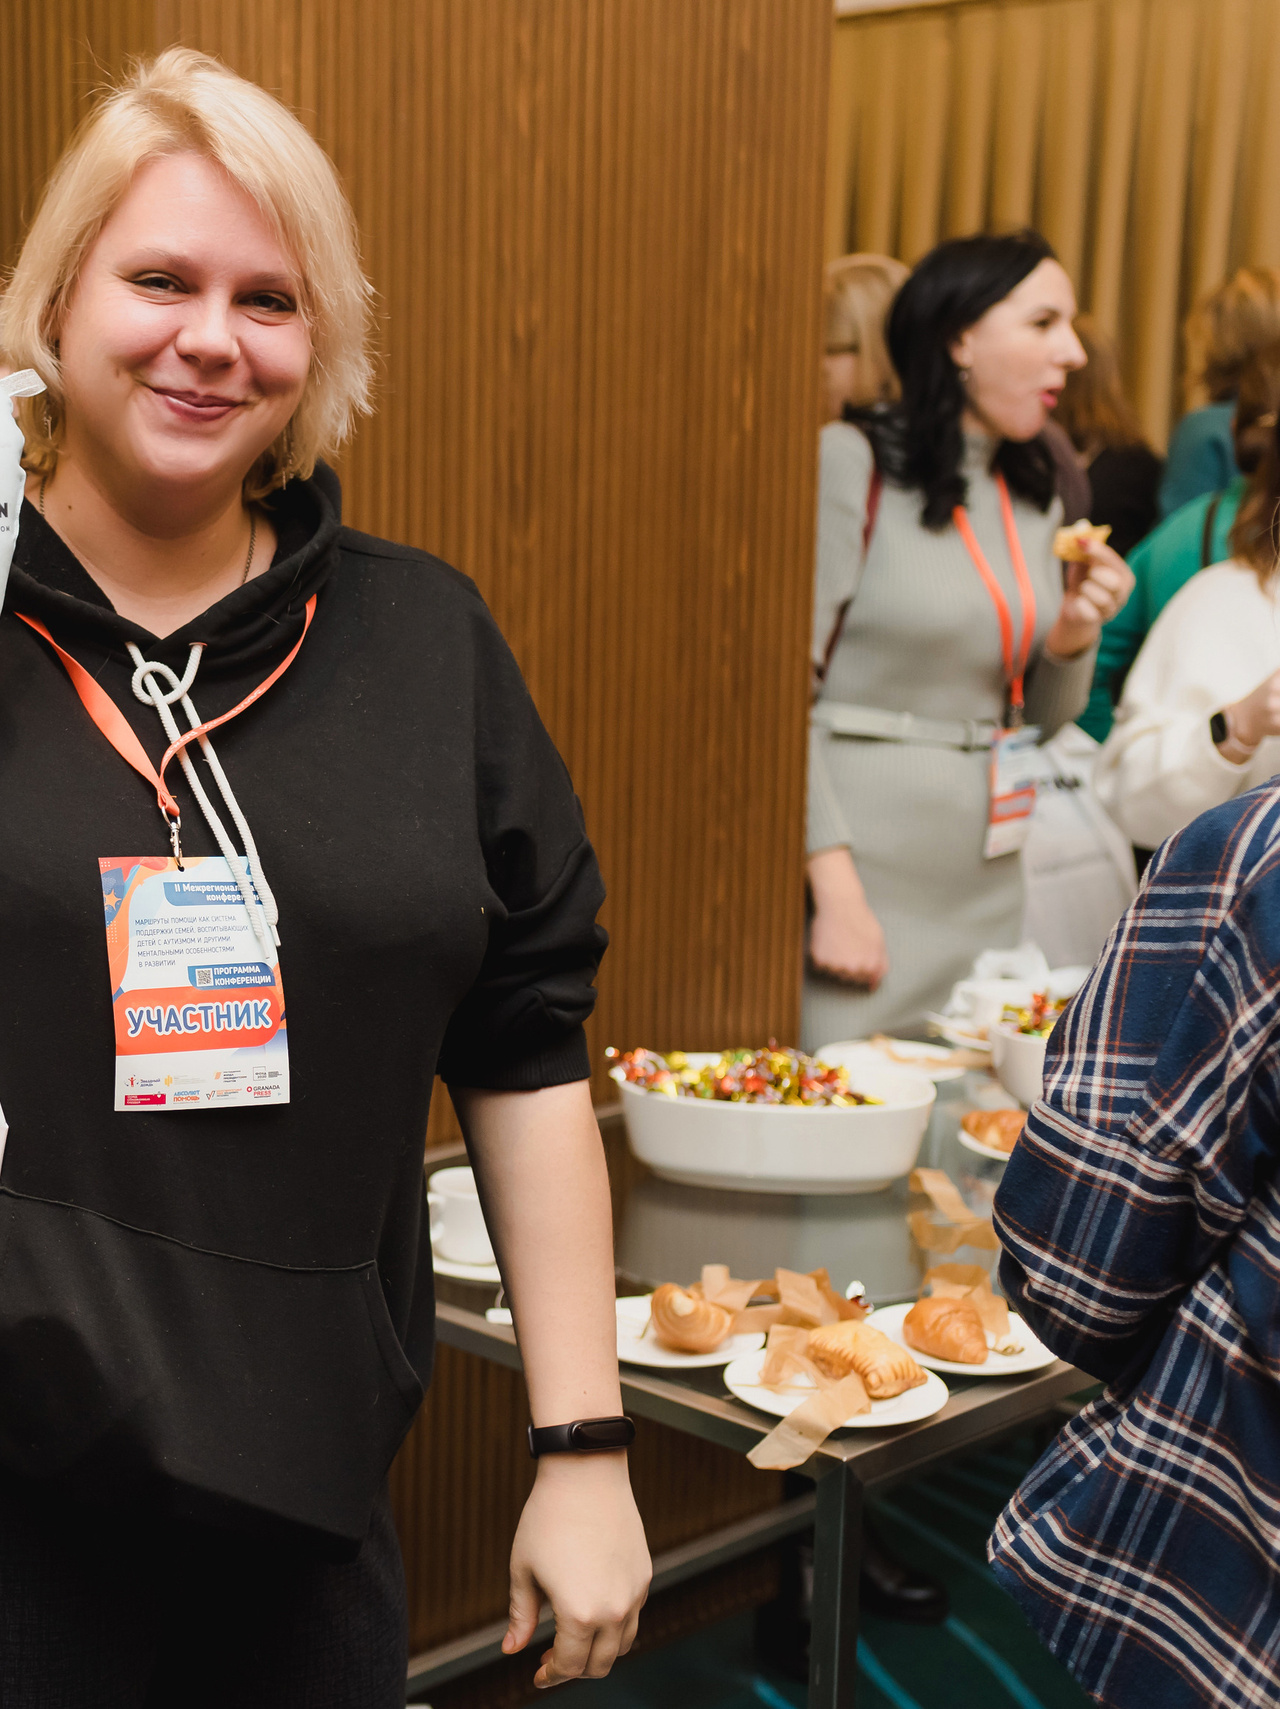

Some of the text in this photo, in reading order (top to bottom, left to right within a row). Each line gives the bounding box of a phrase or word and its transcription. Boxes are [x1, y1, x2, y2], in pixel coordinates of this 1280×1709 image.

[135, 917, 170, 926] МАРШРУТЫ
[136, 928, 173, 936] ПОДДЕРЖКИ
[197, 925, 249, 933] ВОСПИТЫВАЮЩИХ
[137, 939, 156, 947] ДЕТЕЙ
[163, 937, 196, 945] АУТИЗМОМ
[204, 936, 231, 944] ДРУГИМИ
[137, 946, 235, 957] МЕНТАЛЬНЫМИ ОСОБЕННОСТЯМИ
[144, 960, 176, 968] РАЗВИТИИ
[214, 965, 261, 976] ПРОГРАММА
[215, 975, 272, 987] КОНФЕРЕНЦИИ
[125, 999, 272, 1037] УЧАСТНИК
